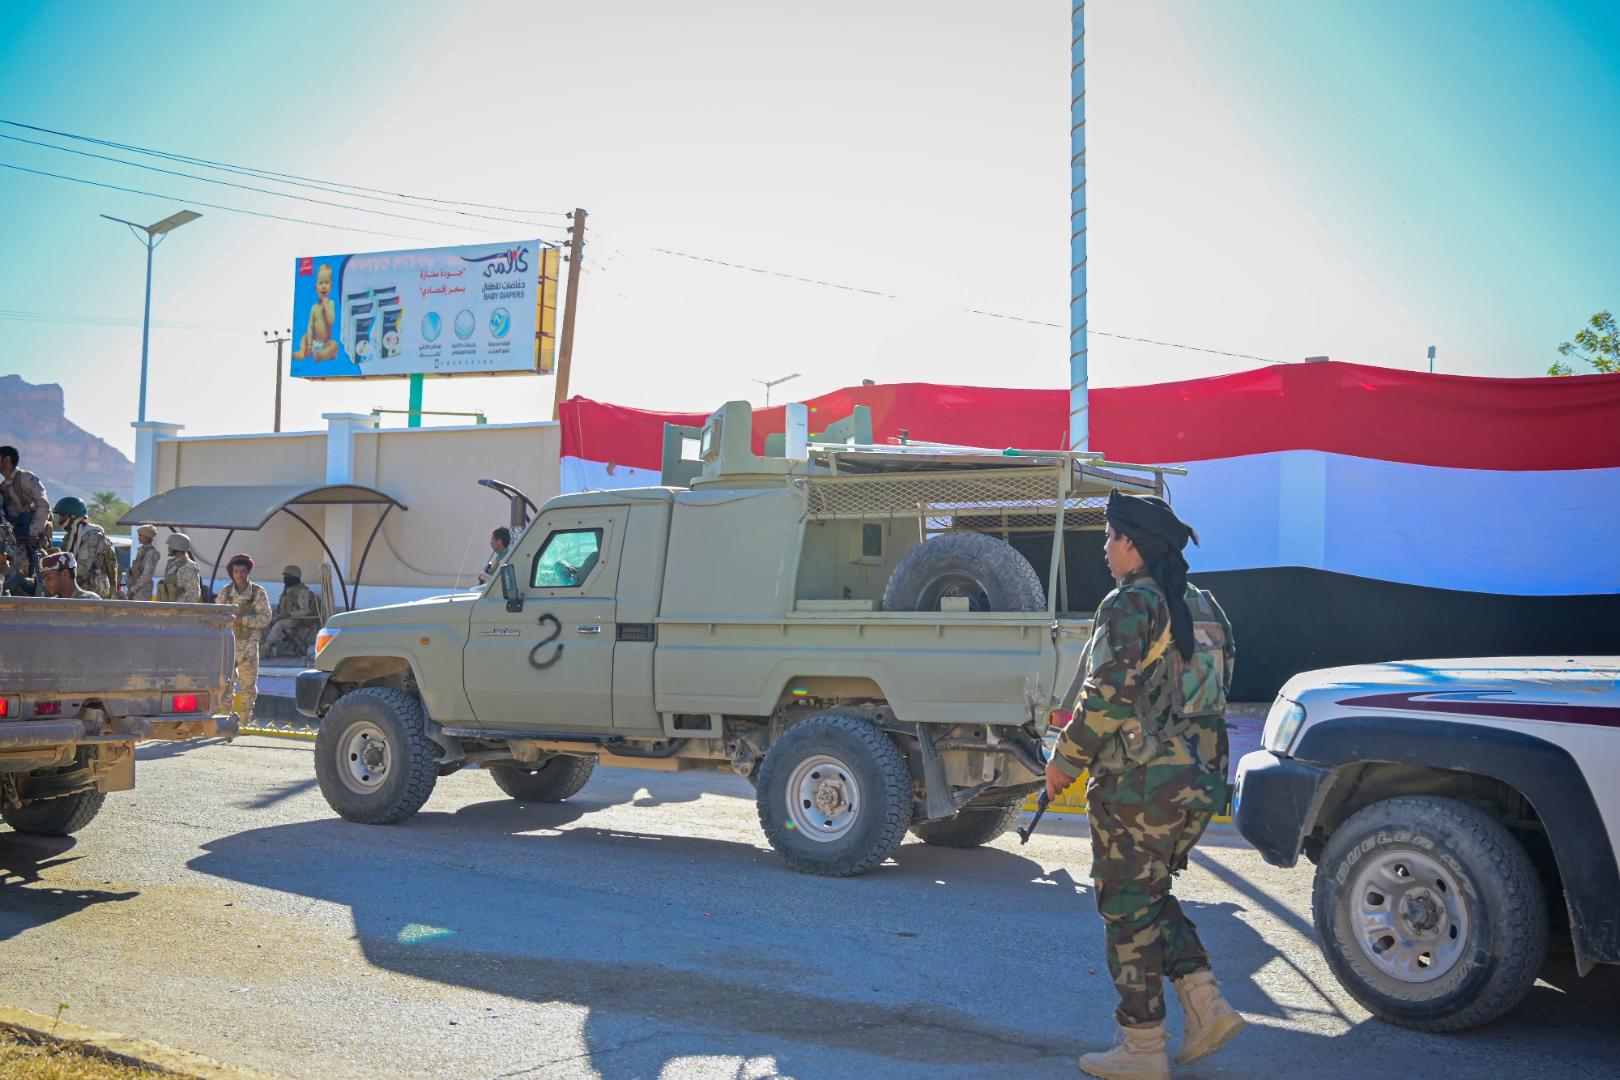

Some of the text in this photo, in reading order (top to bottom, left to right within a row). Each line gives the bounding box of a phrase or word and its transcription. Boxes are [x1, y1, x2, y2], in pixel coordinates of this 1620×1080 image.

[483, 290, 525, 301] BABY DIAPERS
[1336, 831, 1435, 885] DUELER
